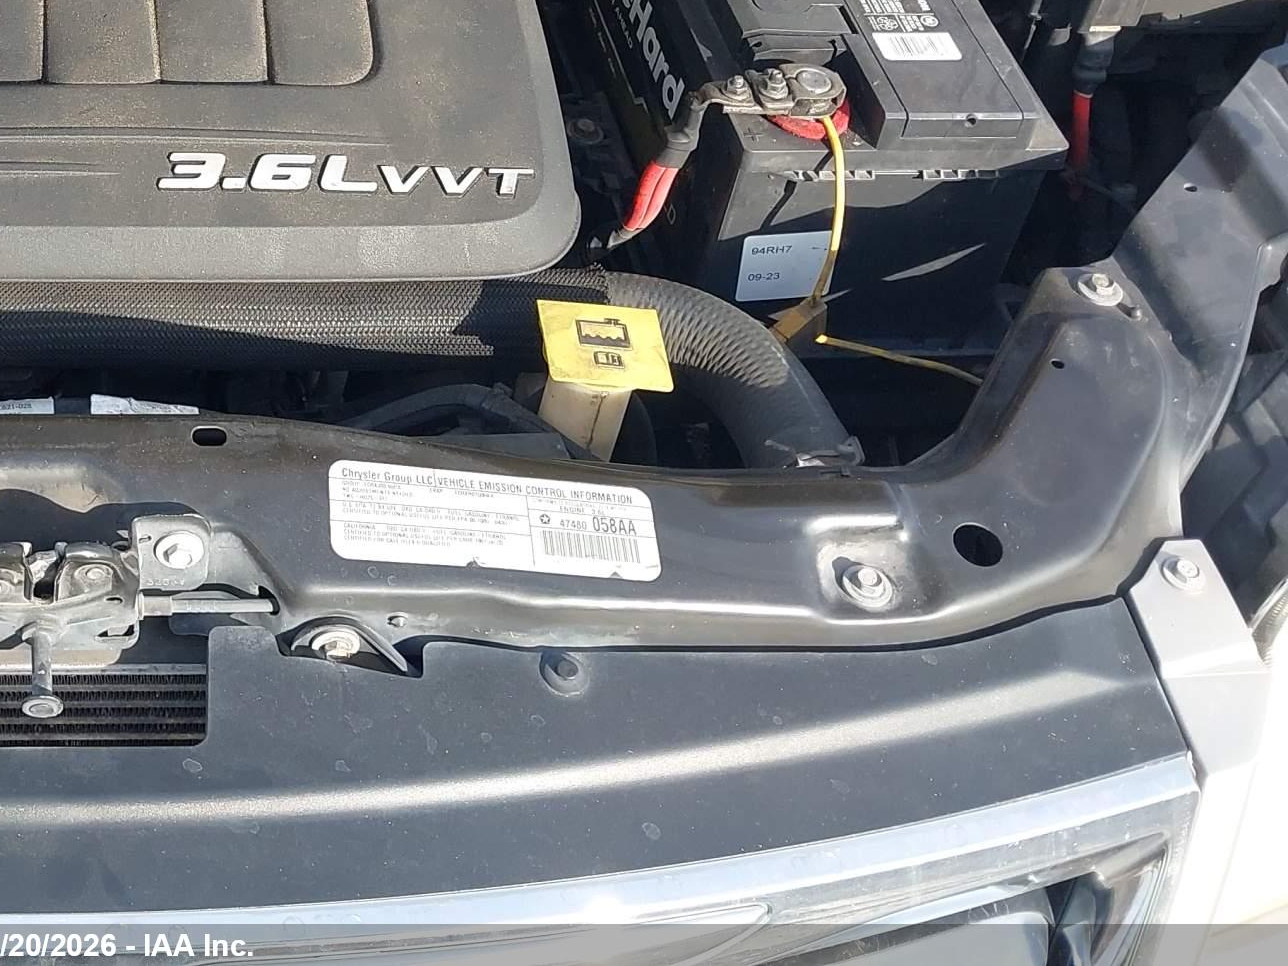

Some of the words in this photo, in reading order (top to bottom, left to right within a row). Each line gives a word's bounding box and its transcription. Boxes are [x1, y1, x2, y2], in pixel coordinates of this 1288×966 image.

[156, 151, 379, 194] 3.6L
[377, 164, 535, 198] VVT
[747, 272, 781, 282] 09-23
[341, 467, 381, 482] Chrysler
[384, 471, 412, 485] Group
[416, 474, 433, 485] LLC
[437, 477, 475, 489] VEHICLE
[479, 481, 522, 494] EMISSION
[526, 485, 567, 499] CONTROL
[570, 490, 633, 505] INFORMATION
[592, 516, 637, 537] 058AA
